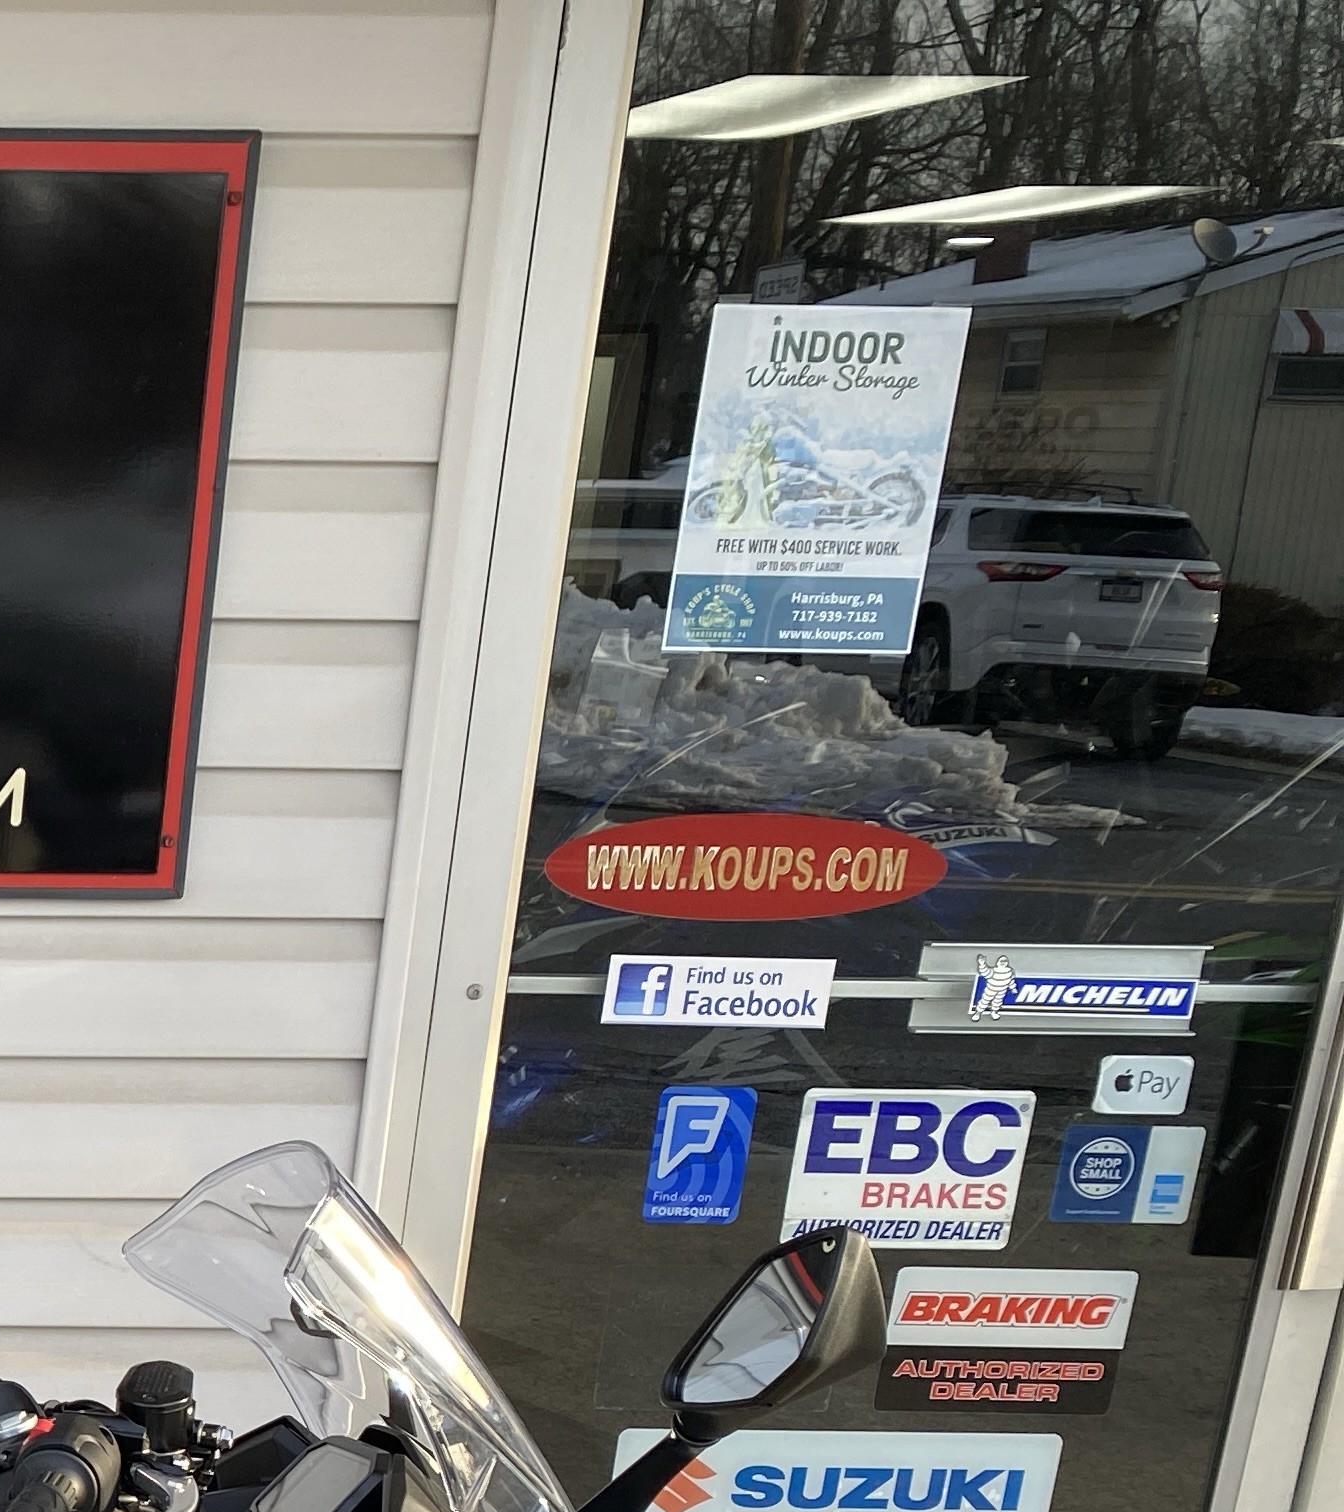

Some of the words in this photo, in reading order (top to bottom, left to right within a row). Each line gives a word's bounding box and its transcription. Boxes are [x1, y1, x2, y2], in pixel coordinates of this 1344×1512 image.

[746, 360, 829, 388] Winter
[833, 364, 920, 400] Storage
[715, 539, 744, 554] FREE
[748, 539, 776, 554] WITH
[781, 540, 811, 556] $400
[814, 540, 862, 556] SERVICE
[791, 592, 865, 606] Harrisburg,
[867, 593, 884, 605] PA
[792, 610, 878, 624] 717-939-7182
[778, 629, 884, 642] www.koups.com
[917, 826, 1008, 844] SUZUKI
[587, 845, 910, 892] WWW.KOUPS.COM
[686, 967, 726, 985] Find
[733, 972, 754, 985] us
[759, 971, 783, 986] on
[682, 989, 817, 1018] Facebook
[1014, 984, 1189, 1007] MICHELIN
[1137, 1070, 1180, 1100] Pay
[804, 1100, 1022, 1177] EBC
[1085, 1157, 1123, 1169] SHOP
[1080, 1168, 1123, 1180] SMALL
[653, 1190, 678, 1202] Find
[681, 1193, 694, 1202] us
[697, 1193, 713, 1202] on
[861, 1182, 1008, 1210] BRAKES
[651, 1206, 731, 1218] FOURSQUARE
[924, 1221, 1005, 1240] DEALER
[898, 1293, 1117, 1327] BRAKING
[893, 1359, 1105, 1381] AUTHORIZED
[929, 1380, 1060, 1402] DEALER
[730, 1465, 1025, 1511] SUZUKI
